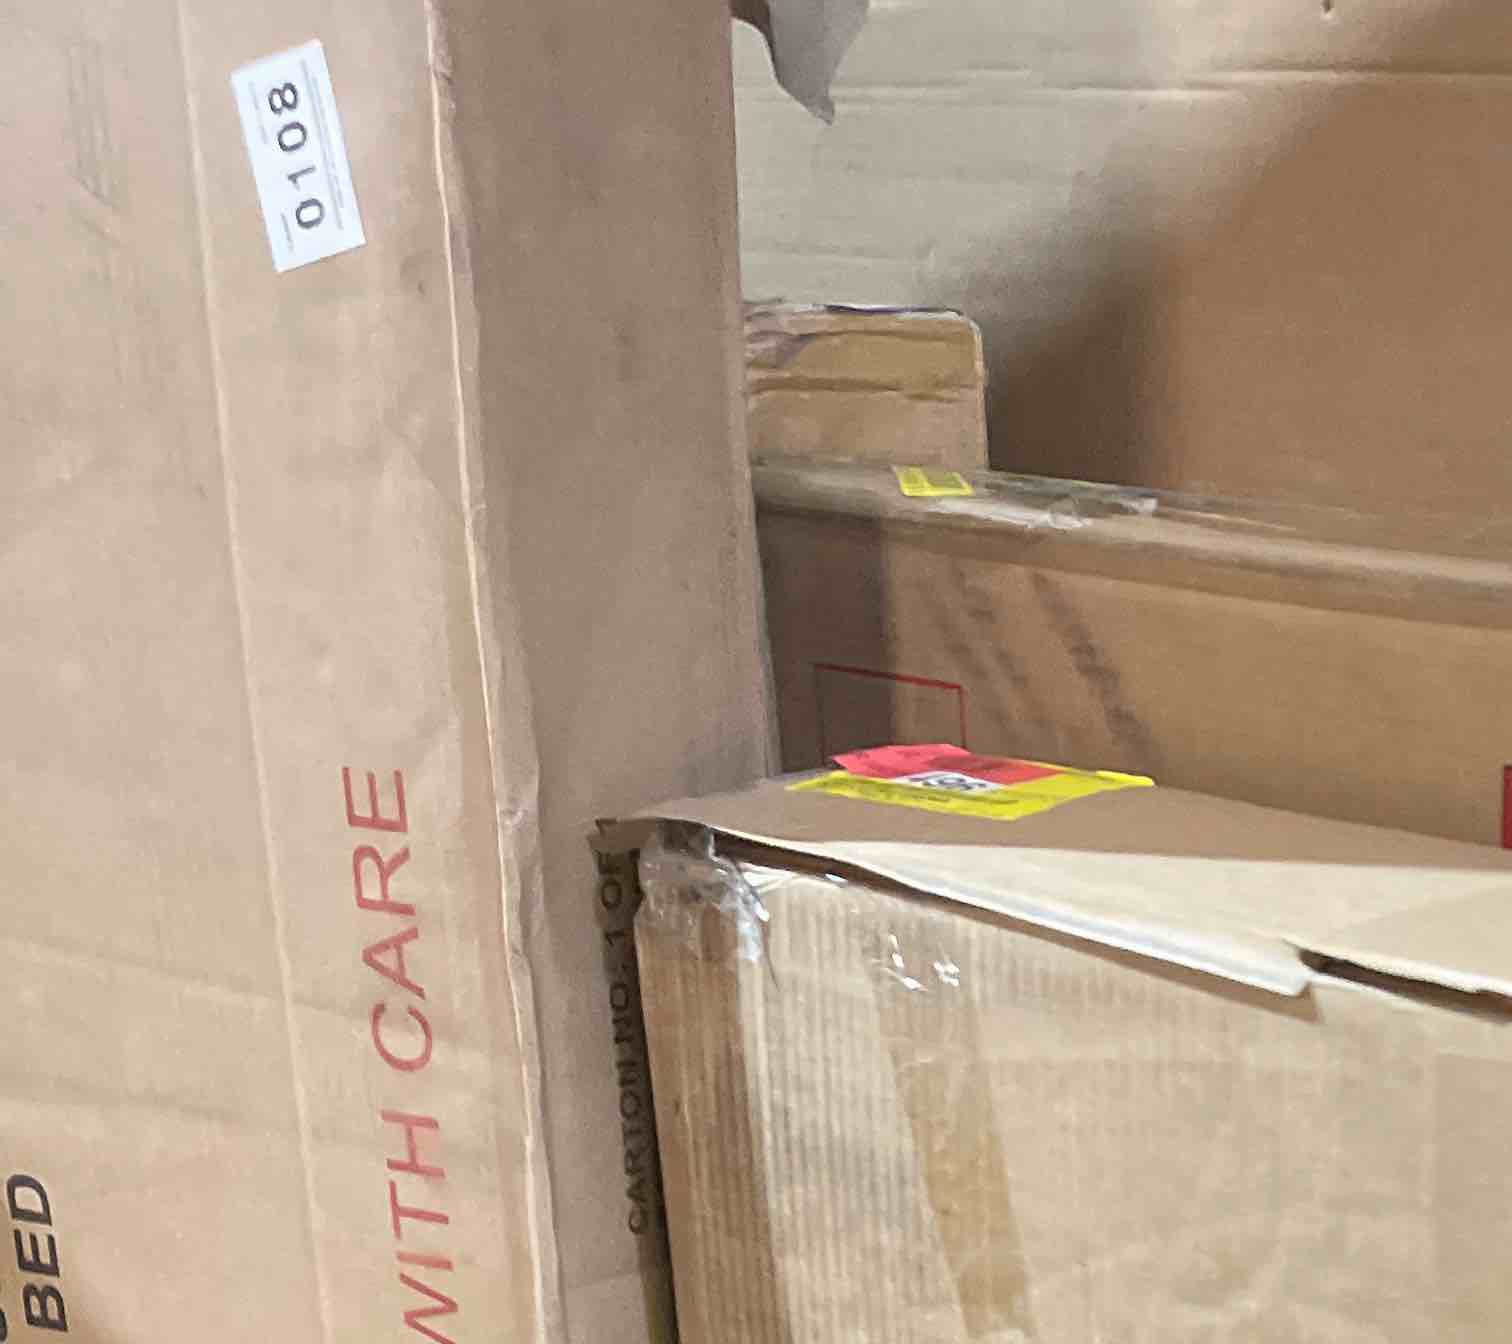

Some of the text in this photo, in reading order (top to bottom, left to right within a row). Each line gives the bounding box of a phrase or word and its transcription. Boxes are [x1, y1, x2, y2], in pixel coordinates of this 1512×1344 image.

[269, 83, 324, 228] 0108
[342, 766, 434, 1072] CARE
[6, 1173, 69, 1334] BED
